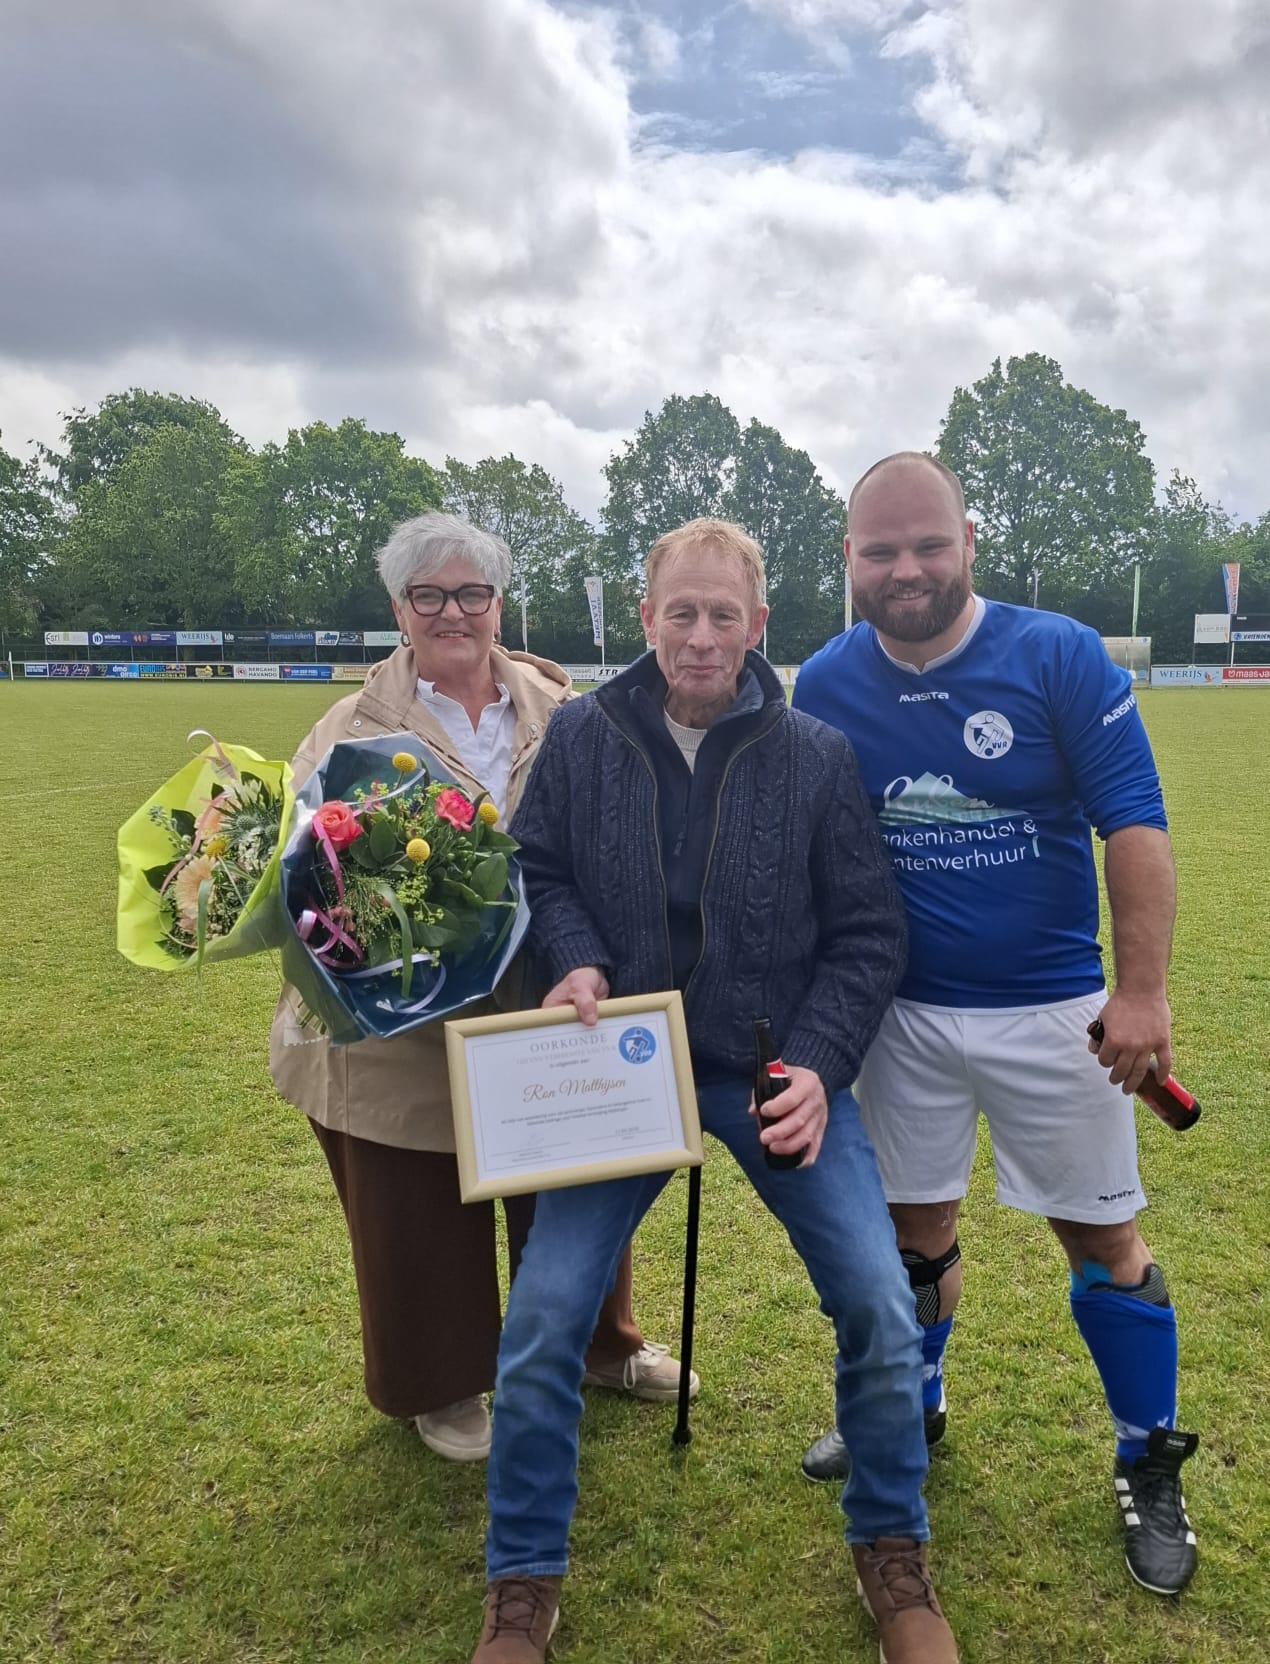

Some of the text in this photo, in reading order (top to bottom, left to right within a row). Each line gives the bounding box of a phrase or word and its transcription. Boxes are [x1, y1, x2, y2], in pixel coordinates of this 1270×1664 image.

[181, 633, 210, 641] WEERIJS
[1159, 670, 1202, 678] WEERIJS
[991, 741, 1008, 749] VVR
[881, 819, 1038, 847] ankenhandel &
[892, 845, 1027, 871] ntenverhuur
[529, 1033, 609, 1053] OORKONDE
[523, 1084, 555, 1103] Ron
